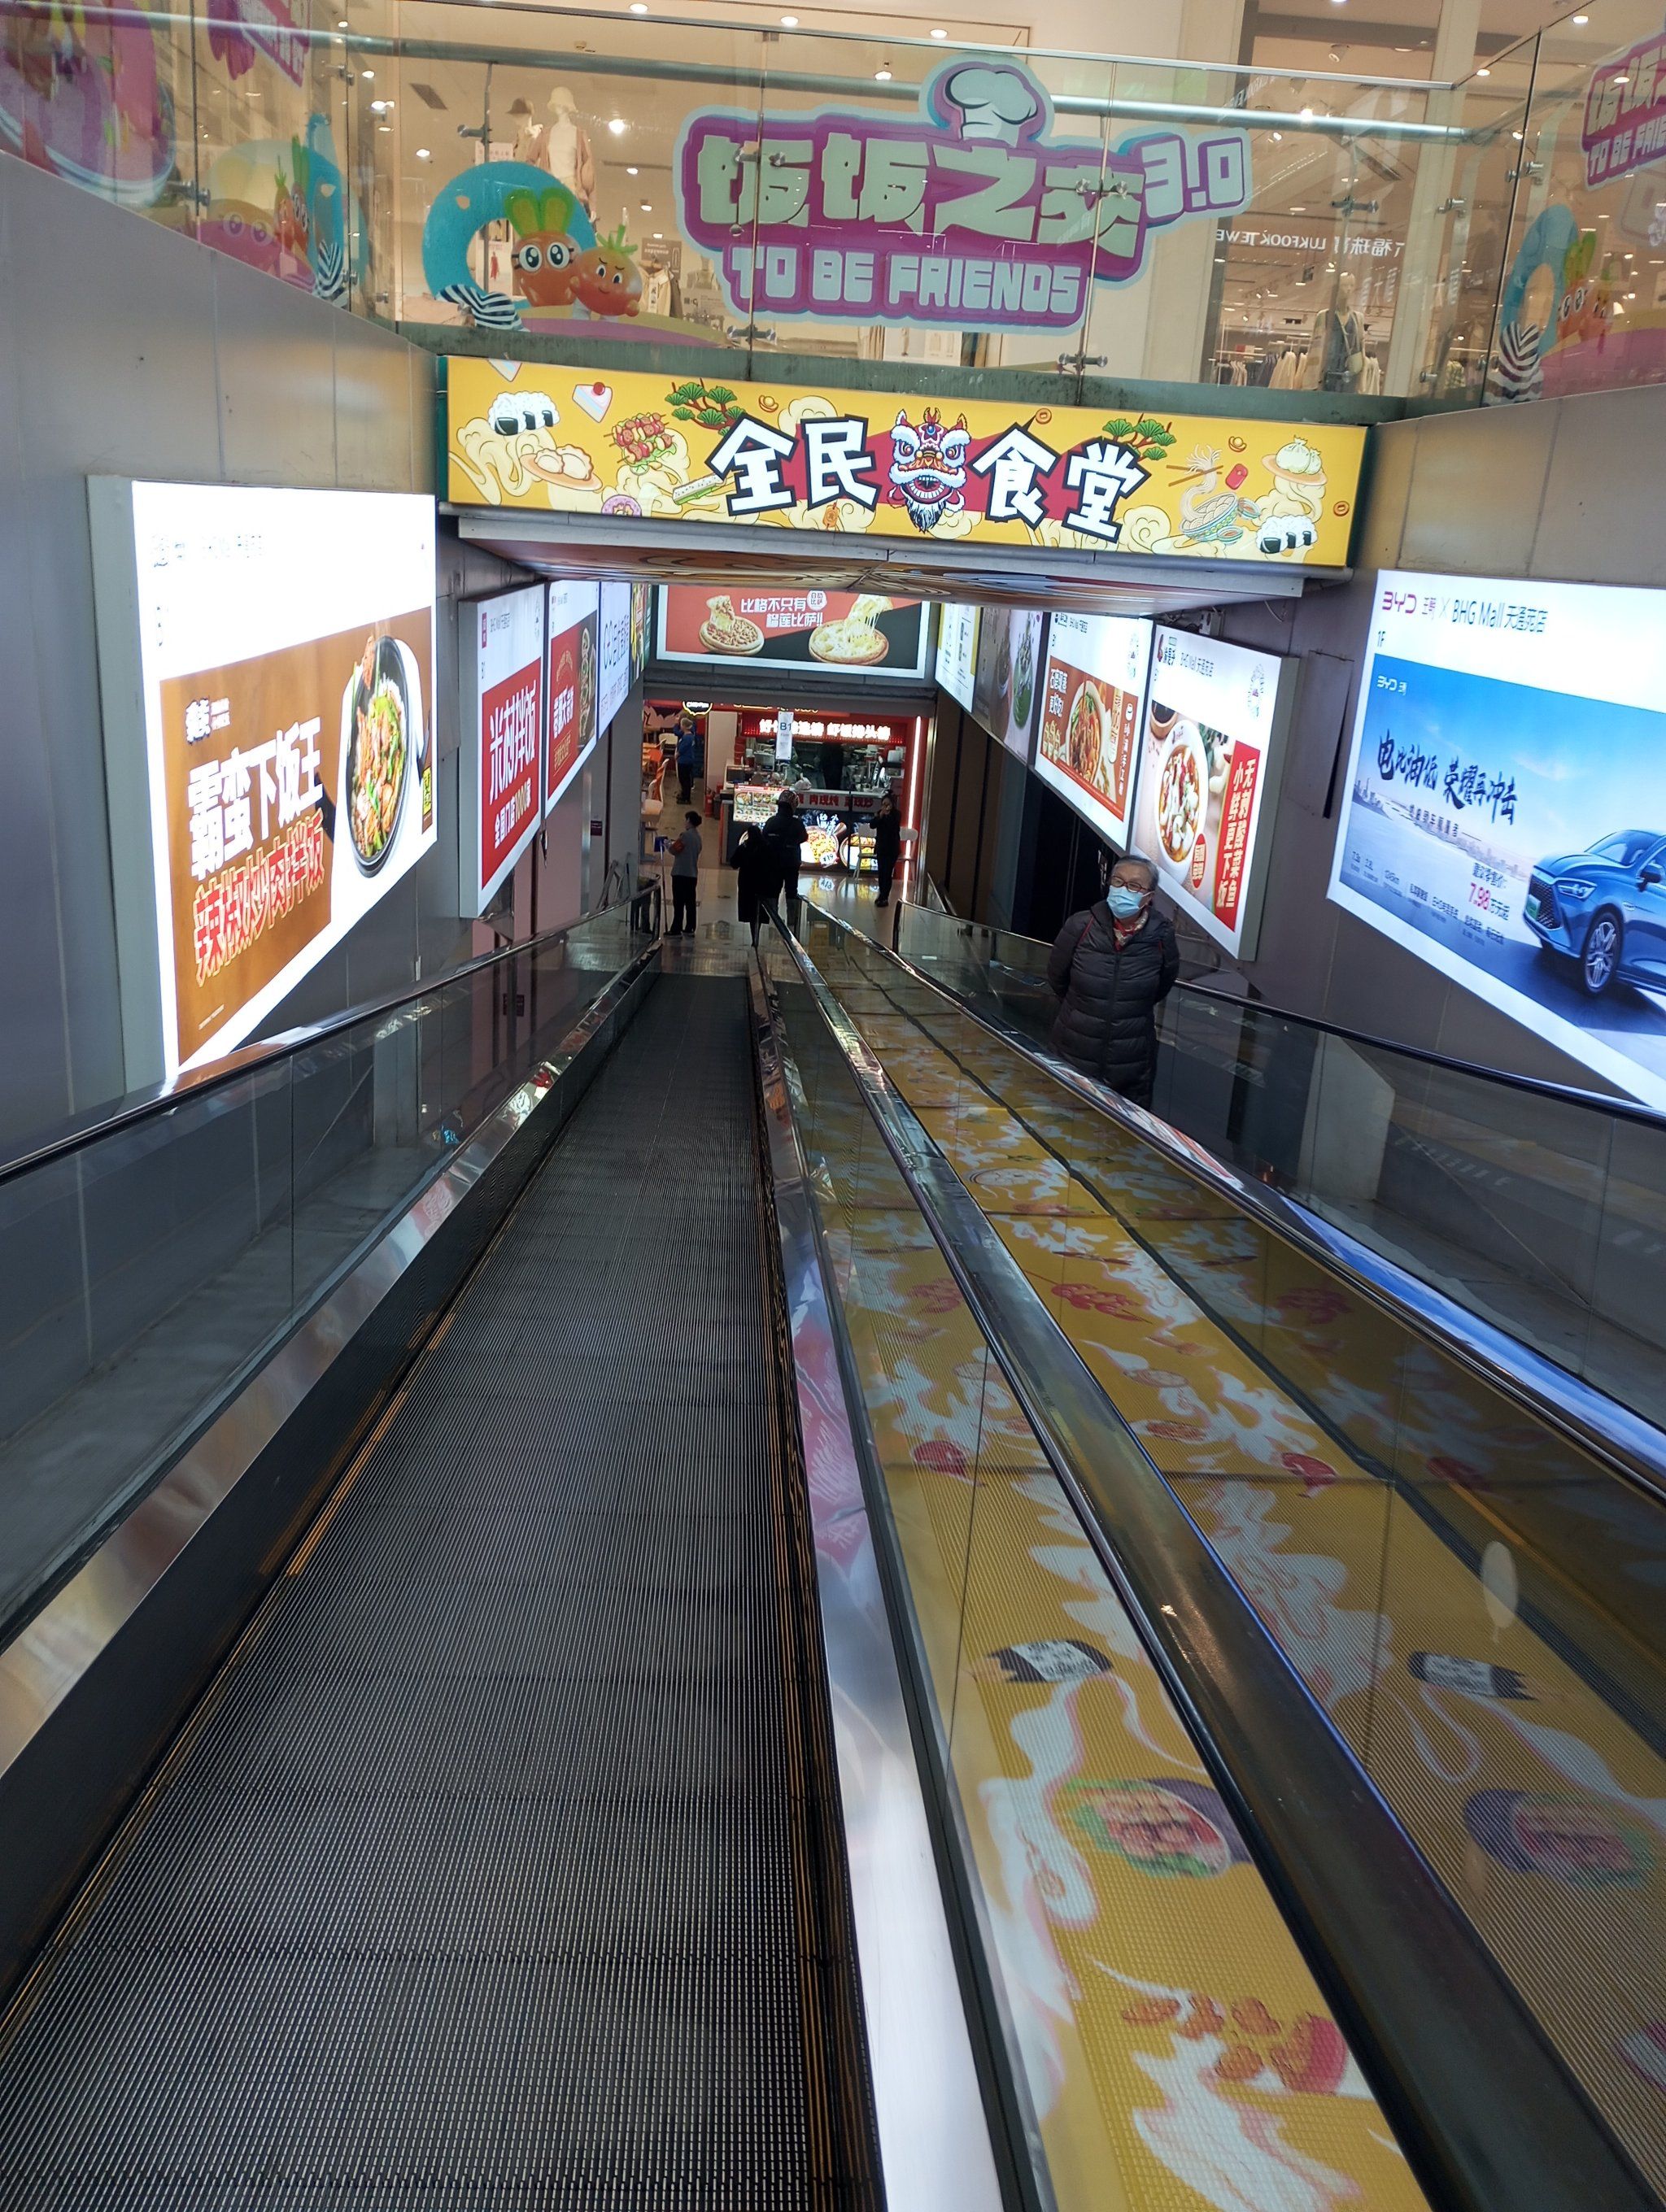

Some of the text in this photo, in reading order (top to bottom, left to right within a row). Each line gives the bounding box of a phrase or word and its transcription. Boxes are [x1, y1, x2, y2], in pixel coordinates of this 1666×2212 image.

[731, 246, 1082, 314] TO BE FRIENDS
[706, 412, 1147, 543] 全民 食堂
[740, 597, 807, 613] 比格不只有
[1382, 590, 1417, 615] BYD
[1452, 599, 1477, 625] BHG
[1479, 601, 1505, 628] Mall
[489, 679, 537, 805] 米村拌饭
[779, 722, 792, 731] B1
[1377, 729, 1438, 791] 电比油低
[1225, 758, 1256, 908] 无刺酸菜鱼
[192, 808, 325, 988] 辣椒炒肉拌饭
